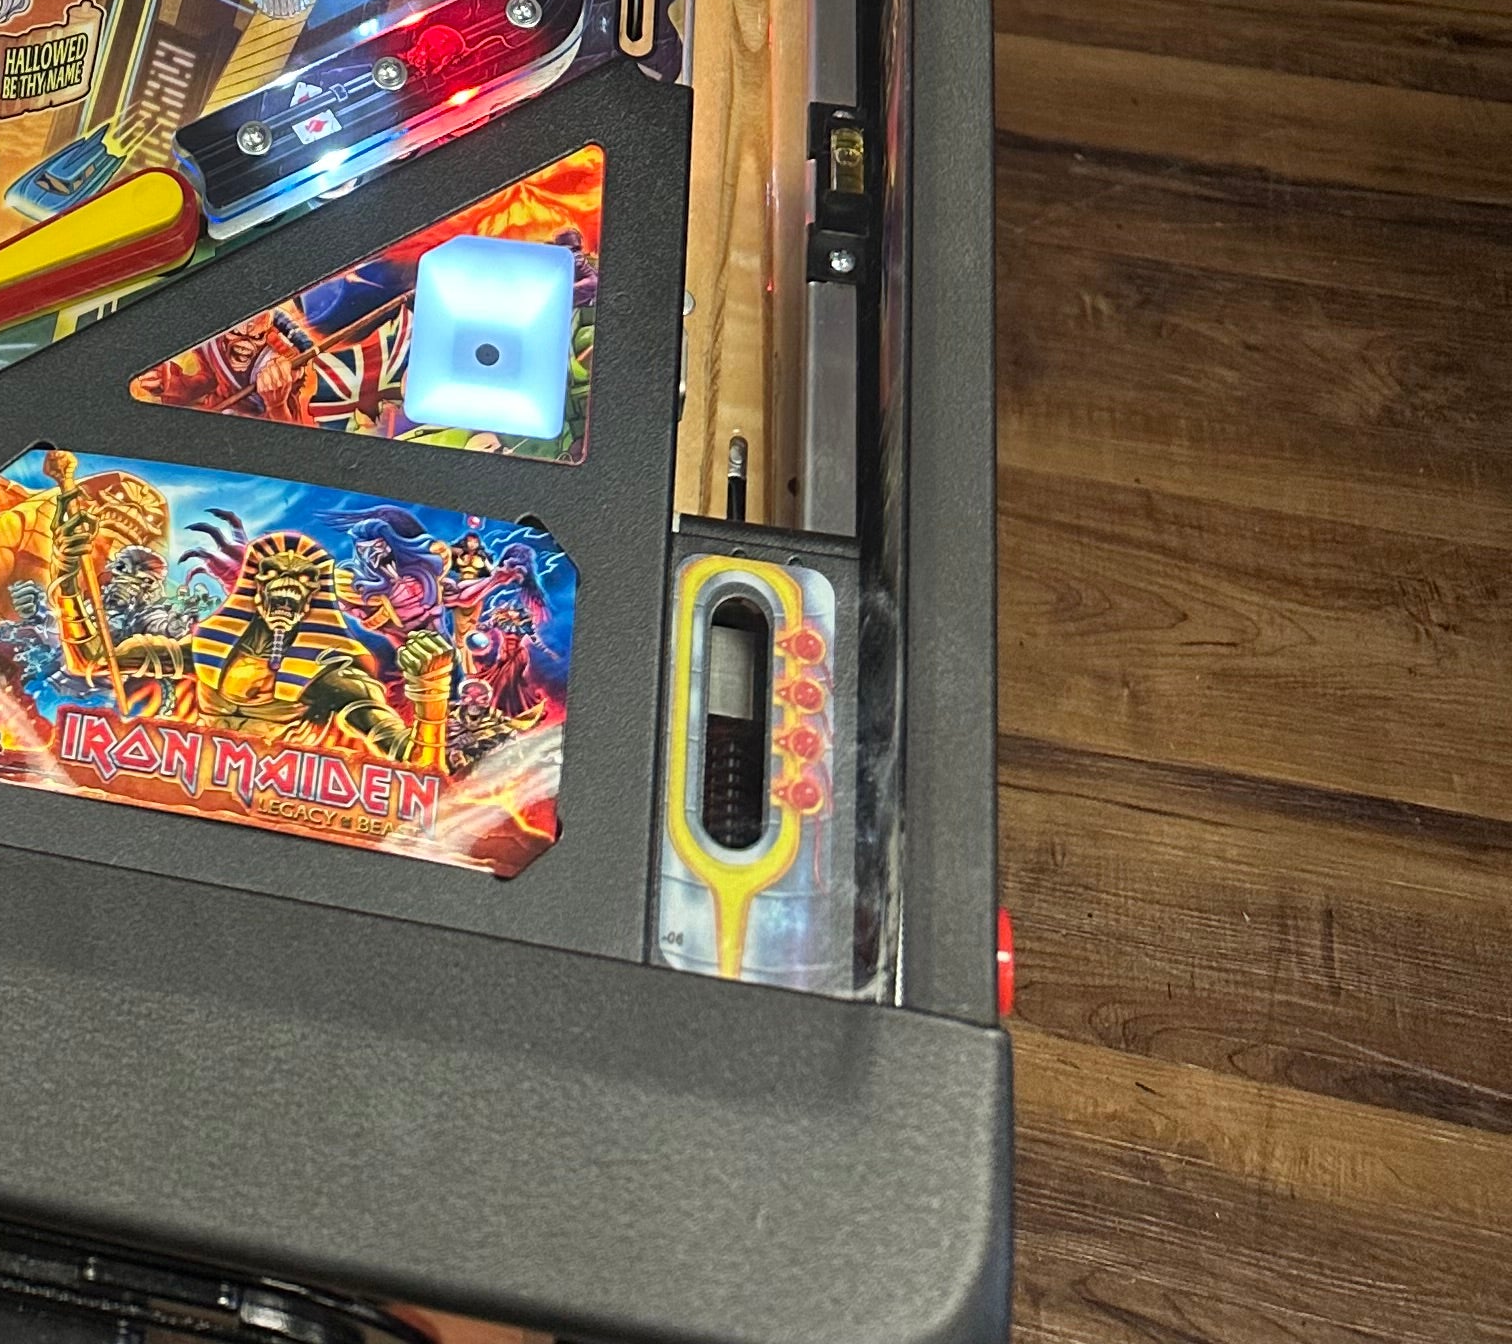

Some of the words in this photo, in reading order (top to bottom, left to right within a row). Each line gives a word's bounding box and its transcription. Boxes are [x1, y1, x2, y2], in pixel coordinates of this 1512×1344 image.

[4, 33, 88, 75] HALLOWED
[2, 76, 19, 100] BE
[20, 71, 46, 98] THY
[45, 60, 83, 93] NAME
[59, 712, 202, 797] IRON
[215, 735, 440, 840] MAIDEN
[255, 797, 337, 826] LEGACY
